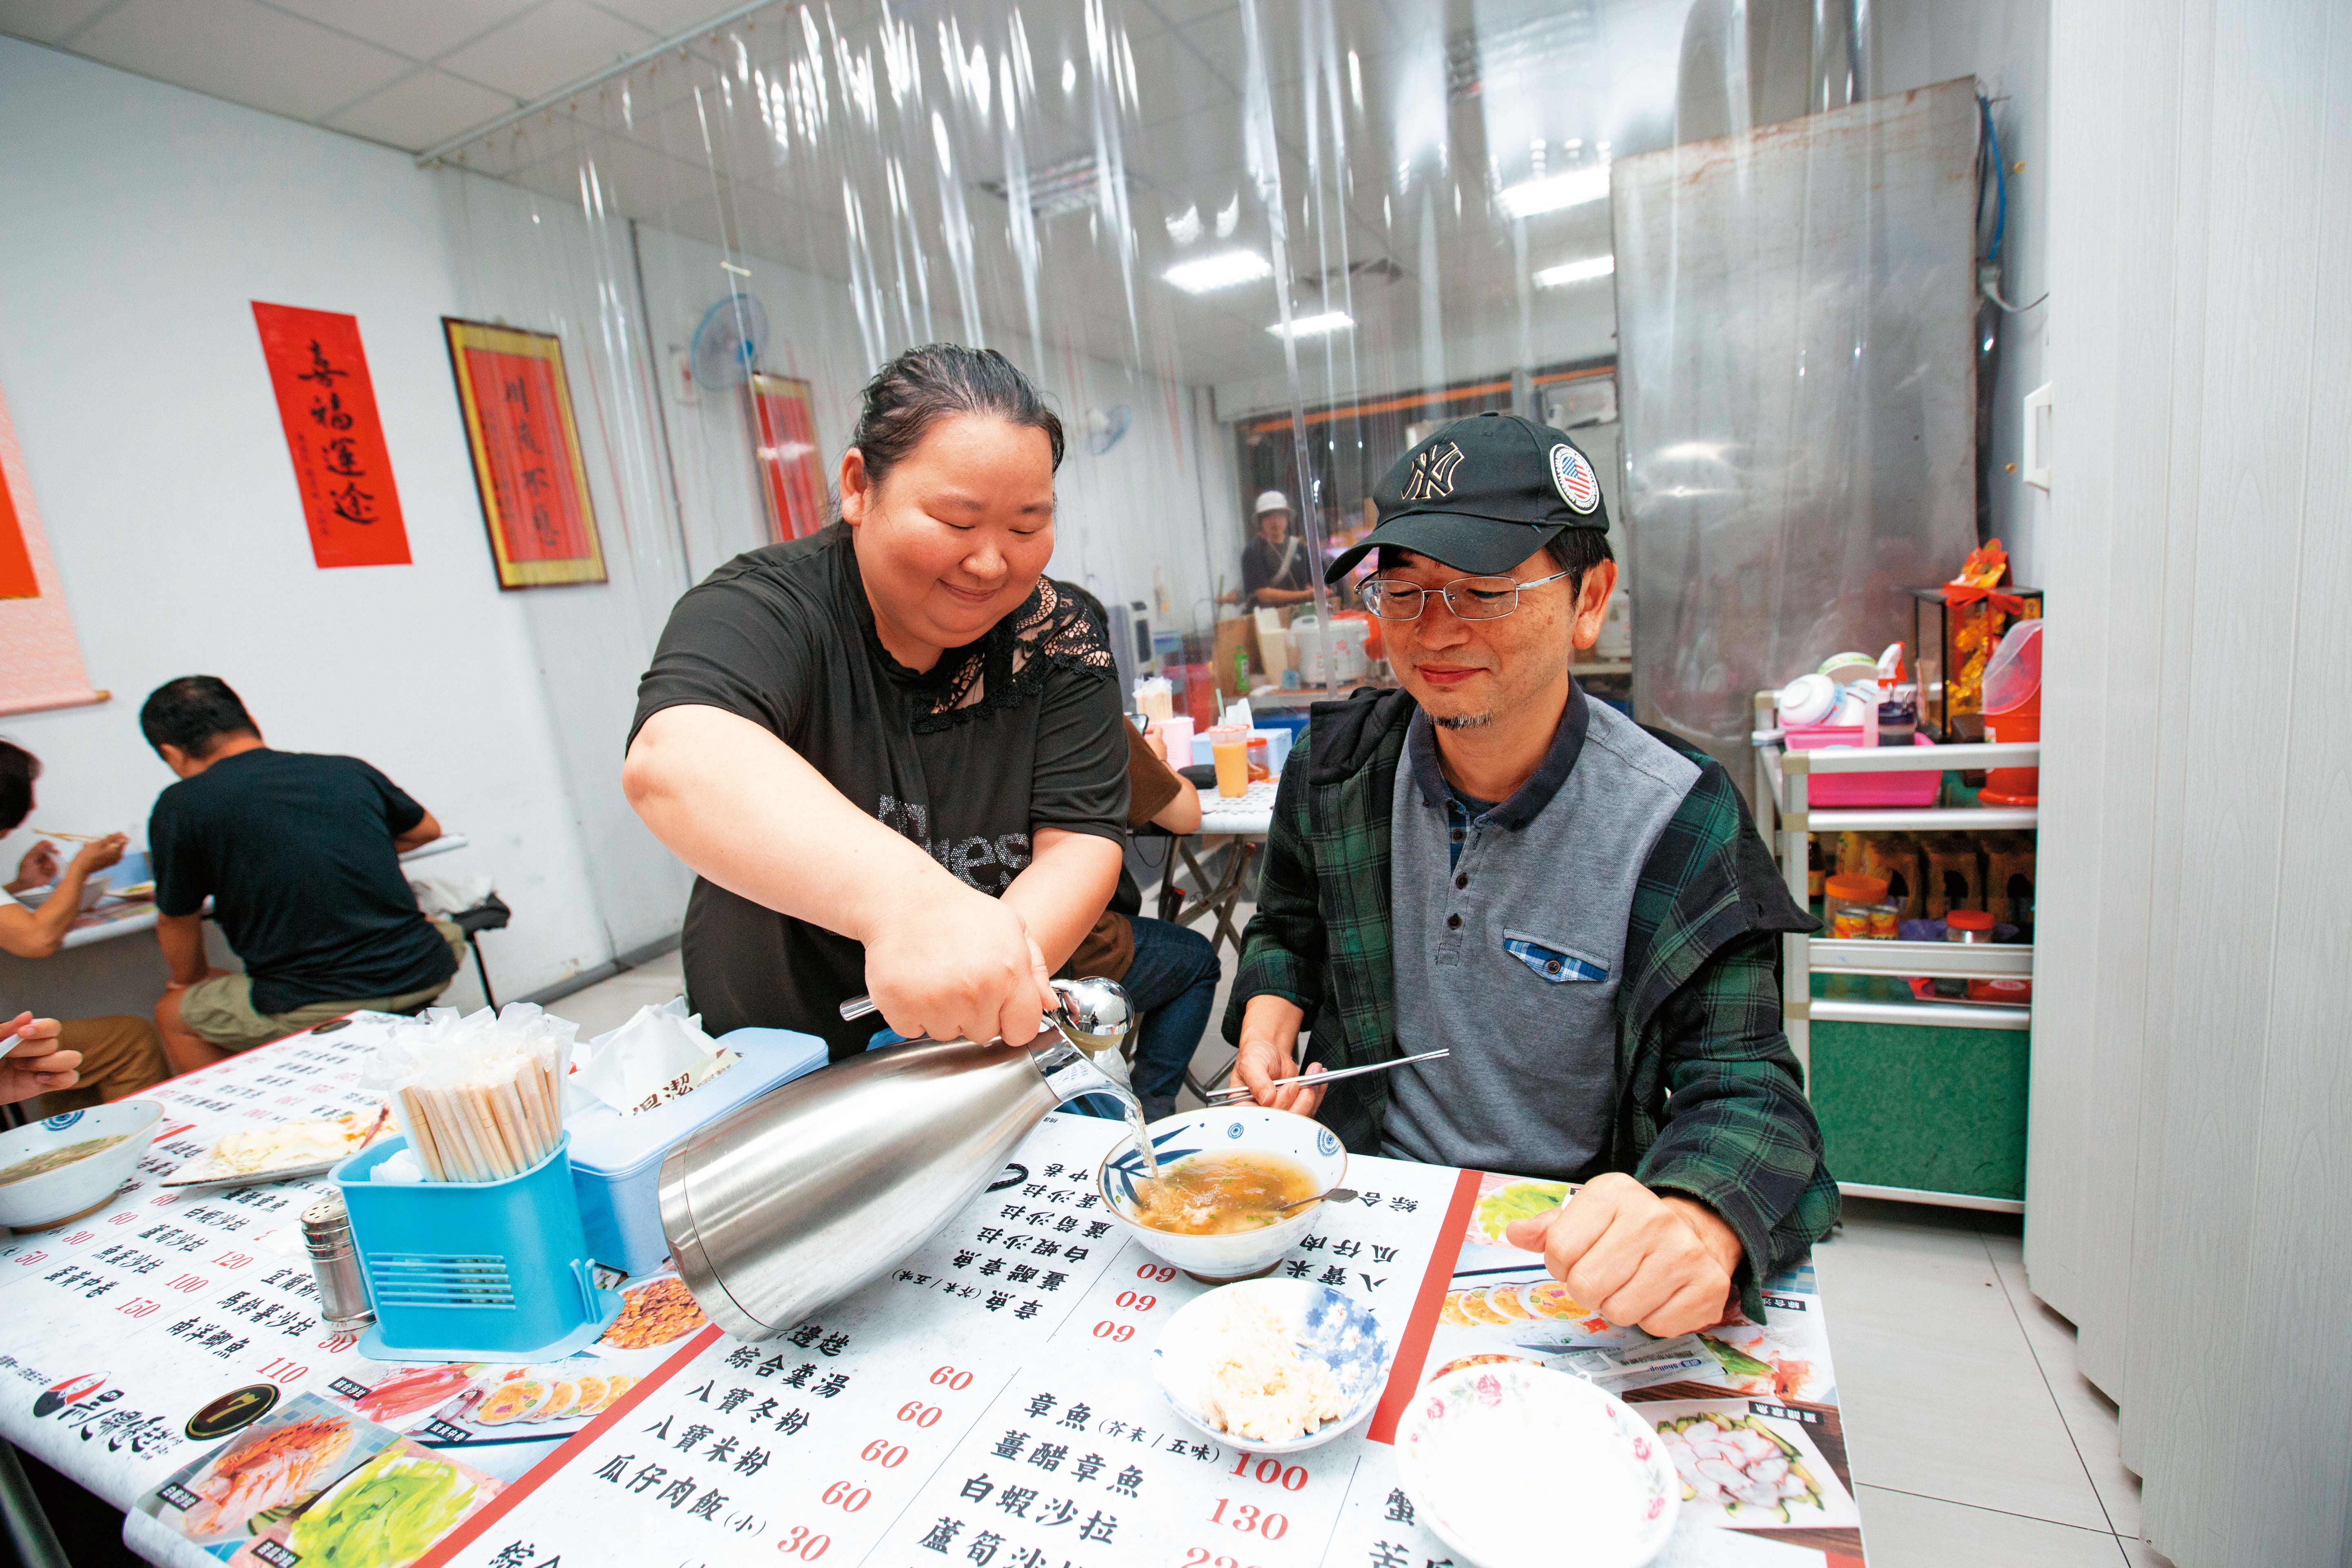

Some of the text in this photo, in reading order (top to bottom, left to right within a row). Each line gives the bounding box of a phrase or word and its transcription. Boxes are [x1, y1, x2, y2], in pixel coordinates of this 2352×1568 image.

[1401, 441, 1465, 500] NY
[149, 1193, 181, 1207] 60
[107, 1211, 139, 1226] 60
[183, 1205, 251, 1232] 白蝦沙拉
[1000, 1204, 1116, 1240] 蘆筍沙拉
[62, 1231, 96, 1245] 30
[977, 1227, 1090, 1264] 白蝦沙拉
[14, 1250, 49, 1267] 50
[91, 1243, 167, 1275] 魚蛋沙拉
[210, 1250, 255, 1271] 120
[1137, 1263, 1177, 1283] 60
[164, 1273, 210, 1294] 100
[114, 1296, 162, 1319] 150
[216, 1290, 318, 1337] 馬鈴薯沙拉
[1115, 1290, 1157, 1312] 60
[1092, 1320, 1136, 1343] 60
[256, 1356, 310, 1384] 110
[724, 1345, 851, 1399] 綜合羹湯
[929, 1365, 974, 1392] 60
[684, 1379, 810, 1436] 八寶冬粉
[896, 1401, 943, 1429] 60
[640, 1414, 772, 1477] 八寶米粉
[860, 1438, 909, 1469] 60
[990, 1429, 1144, 1498] 薑醋章魚
[1227, 1452, 1309, 1492] 100
[821, 1480, 872, 1513] 60
[960, 1472, 1118, 1544] 白蝦沙拉
[1205, 1498, 1290, 1540] 130
[777, 1526, 831, 1562] 30
